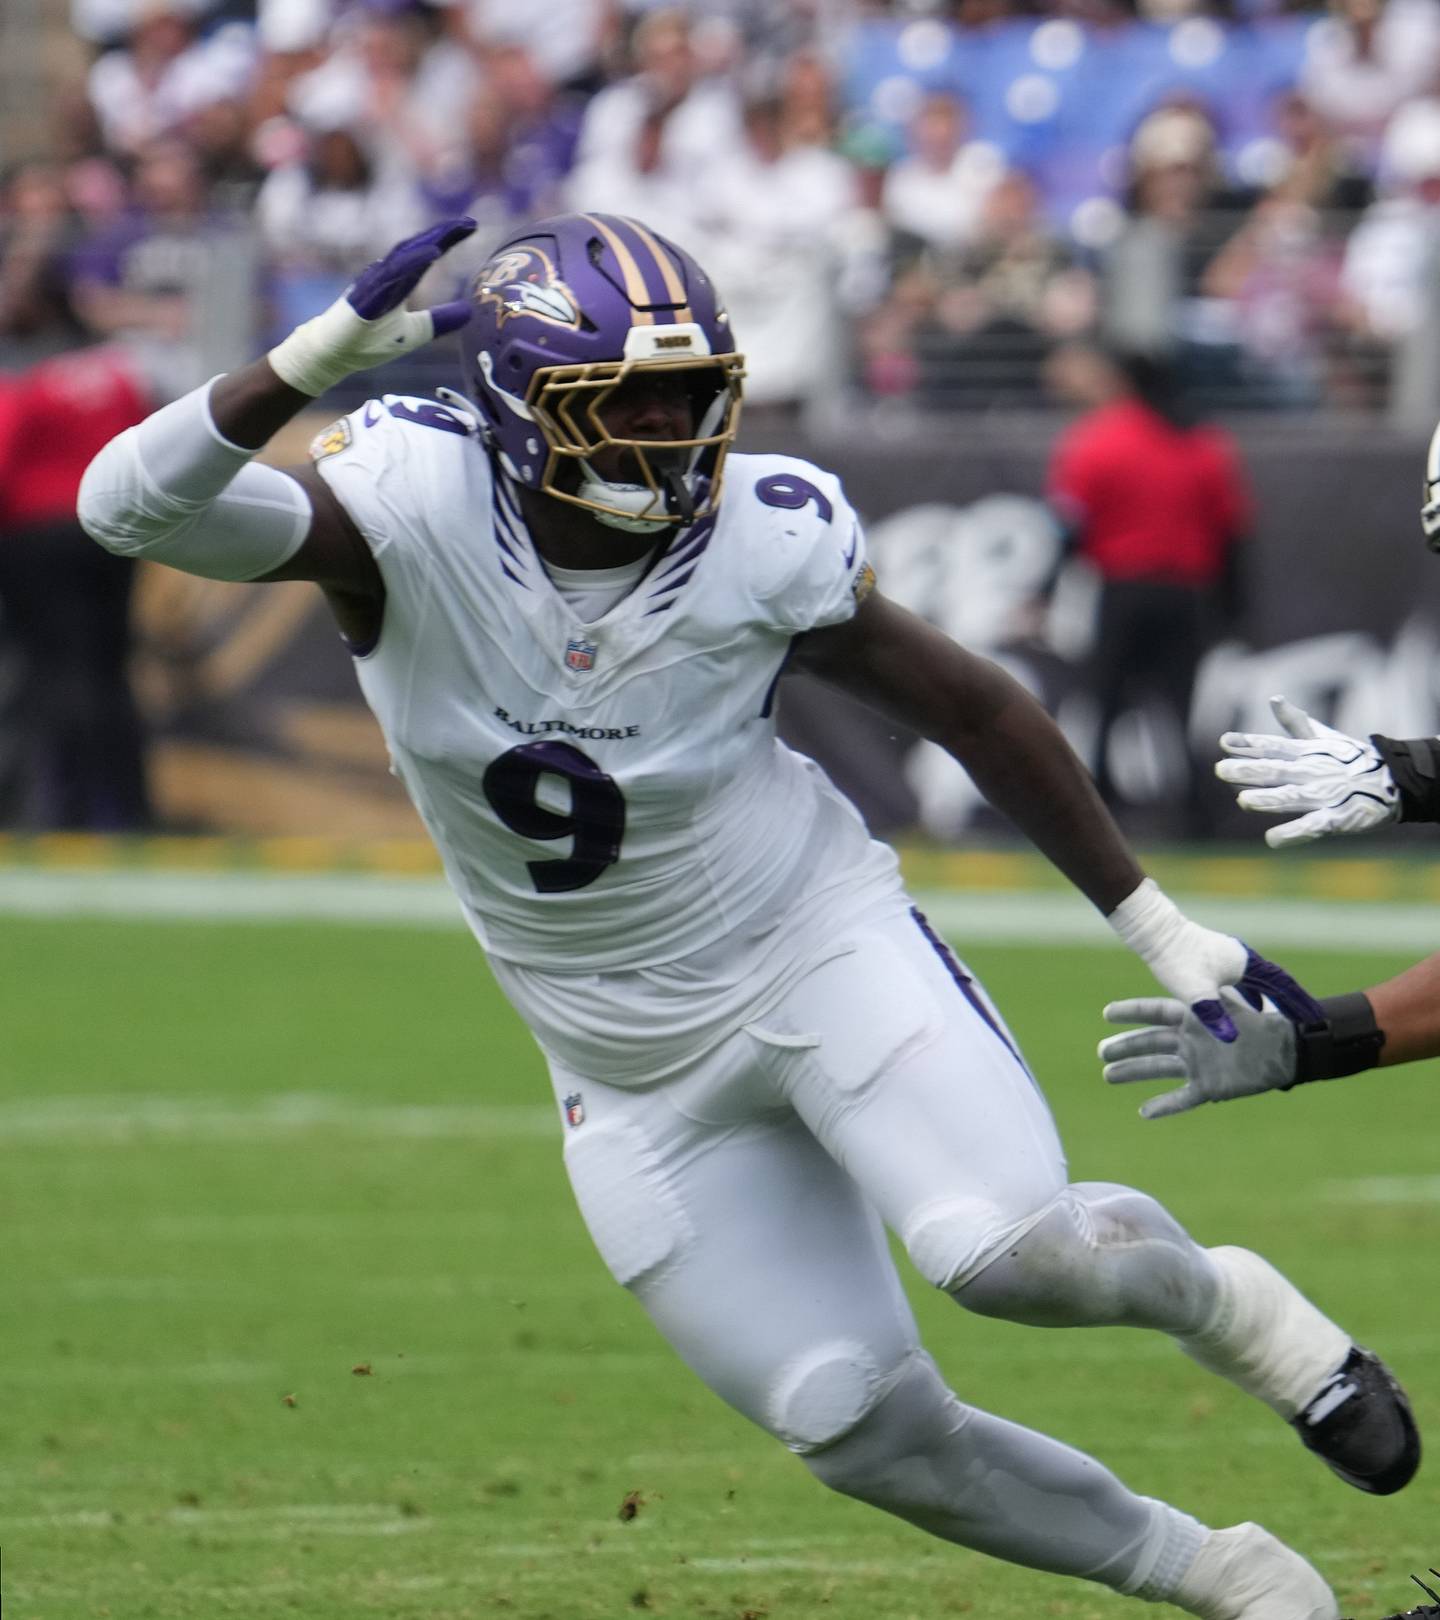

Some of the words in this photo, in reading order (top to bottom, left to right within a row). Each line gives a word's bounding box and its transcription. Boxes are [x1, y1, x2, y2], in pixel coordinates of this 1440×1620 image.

[755, 473, 833, 525] 9
[493, 705, 641, 740] BALTIMORE
[482, 740, 626, 893] 9
